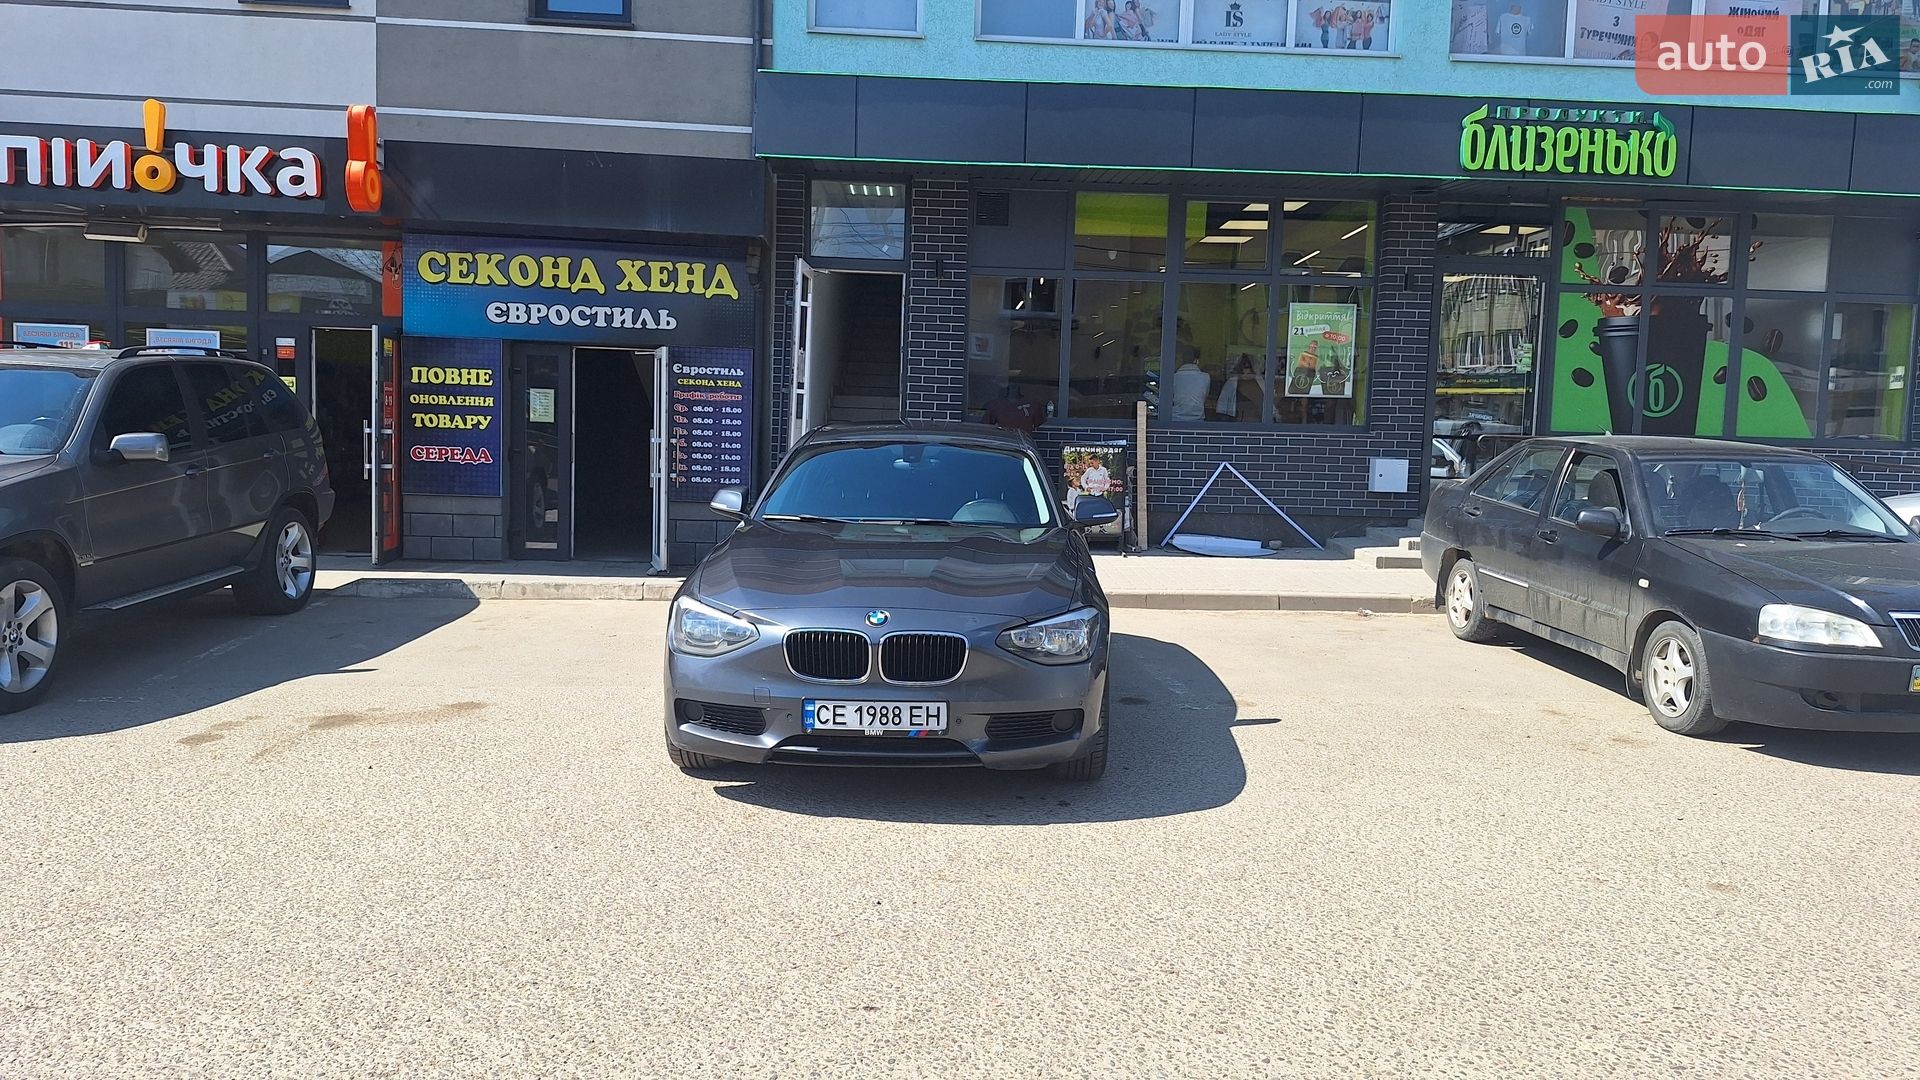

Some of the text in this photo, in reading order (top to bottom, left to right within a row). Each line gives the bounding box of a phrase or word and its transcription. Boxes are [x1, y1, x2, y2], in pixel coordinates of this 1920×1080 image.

[1496, 106, 1647, 124] ПРОДУКТИ
[1460, 104, 1678, 177] близенько
[417, 250, 739, 300] СЕКОНД ХЕНД
[486, 301, 678, 331] ЄВРОСТИЛЬ
[1293, 327, 1304, 335] 21
[410, 366, 493, 386] ПОВНЕ
[672, 363, 744, 376] Євростиль
[677, 378, 742, 388] СЕКОНД ХЕНД
[409, 394, 494, 407] ОНОВЛЕННЯ
[721, 406, 742, 414] 18.00
[411, 413, 493, 430] ТОВАРУ
[721, 418, 742, 426] 18.00
[721, 430, 741, 438] 18.00
[410, 445, 494, 464] СЕРЕДА
[691, 452, 712, 460] 08.00
[720, 453, 741, 461] 16.00
[691, 464, 712, 472] 08.00
[720, 465, 741, 473] 18.00
[816, 704, 941, 726] CE 1988 EH
[864, 729, 884, 737] BMW
